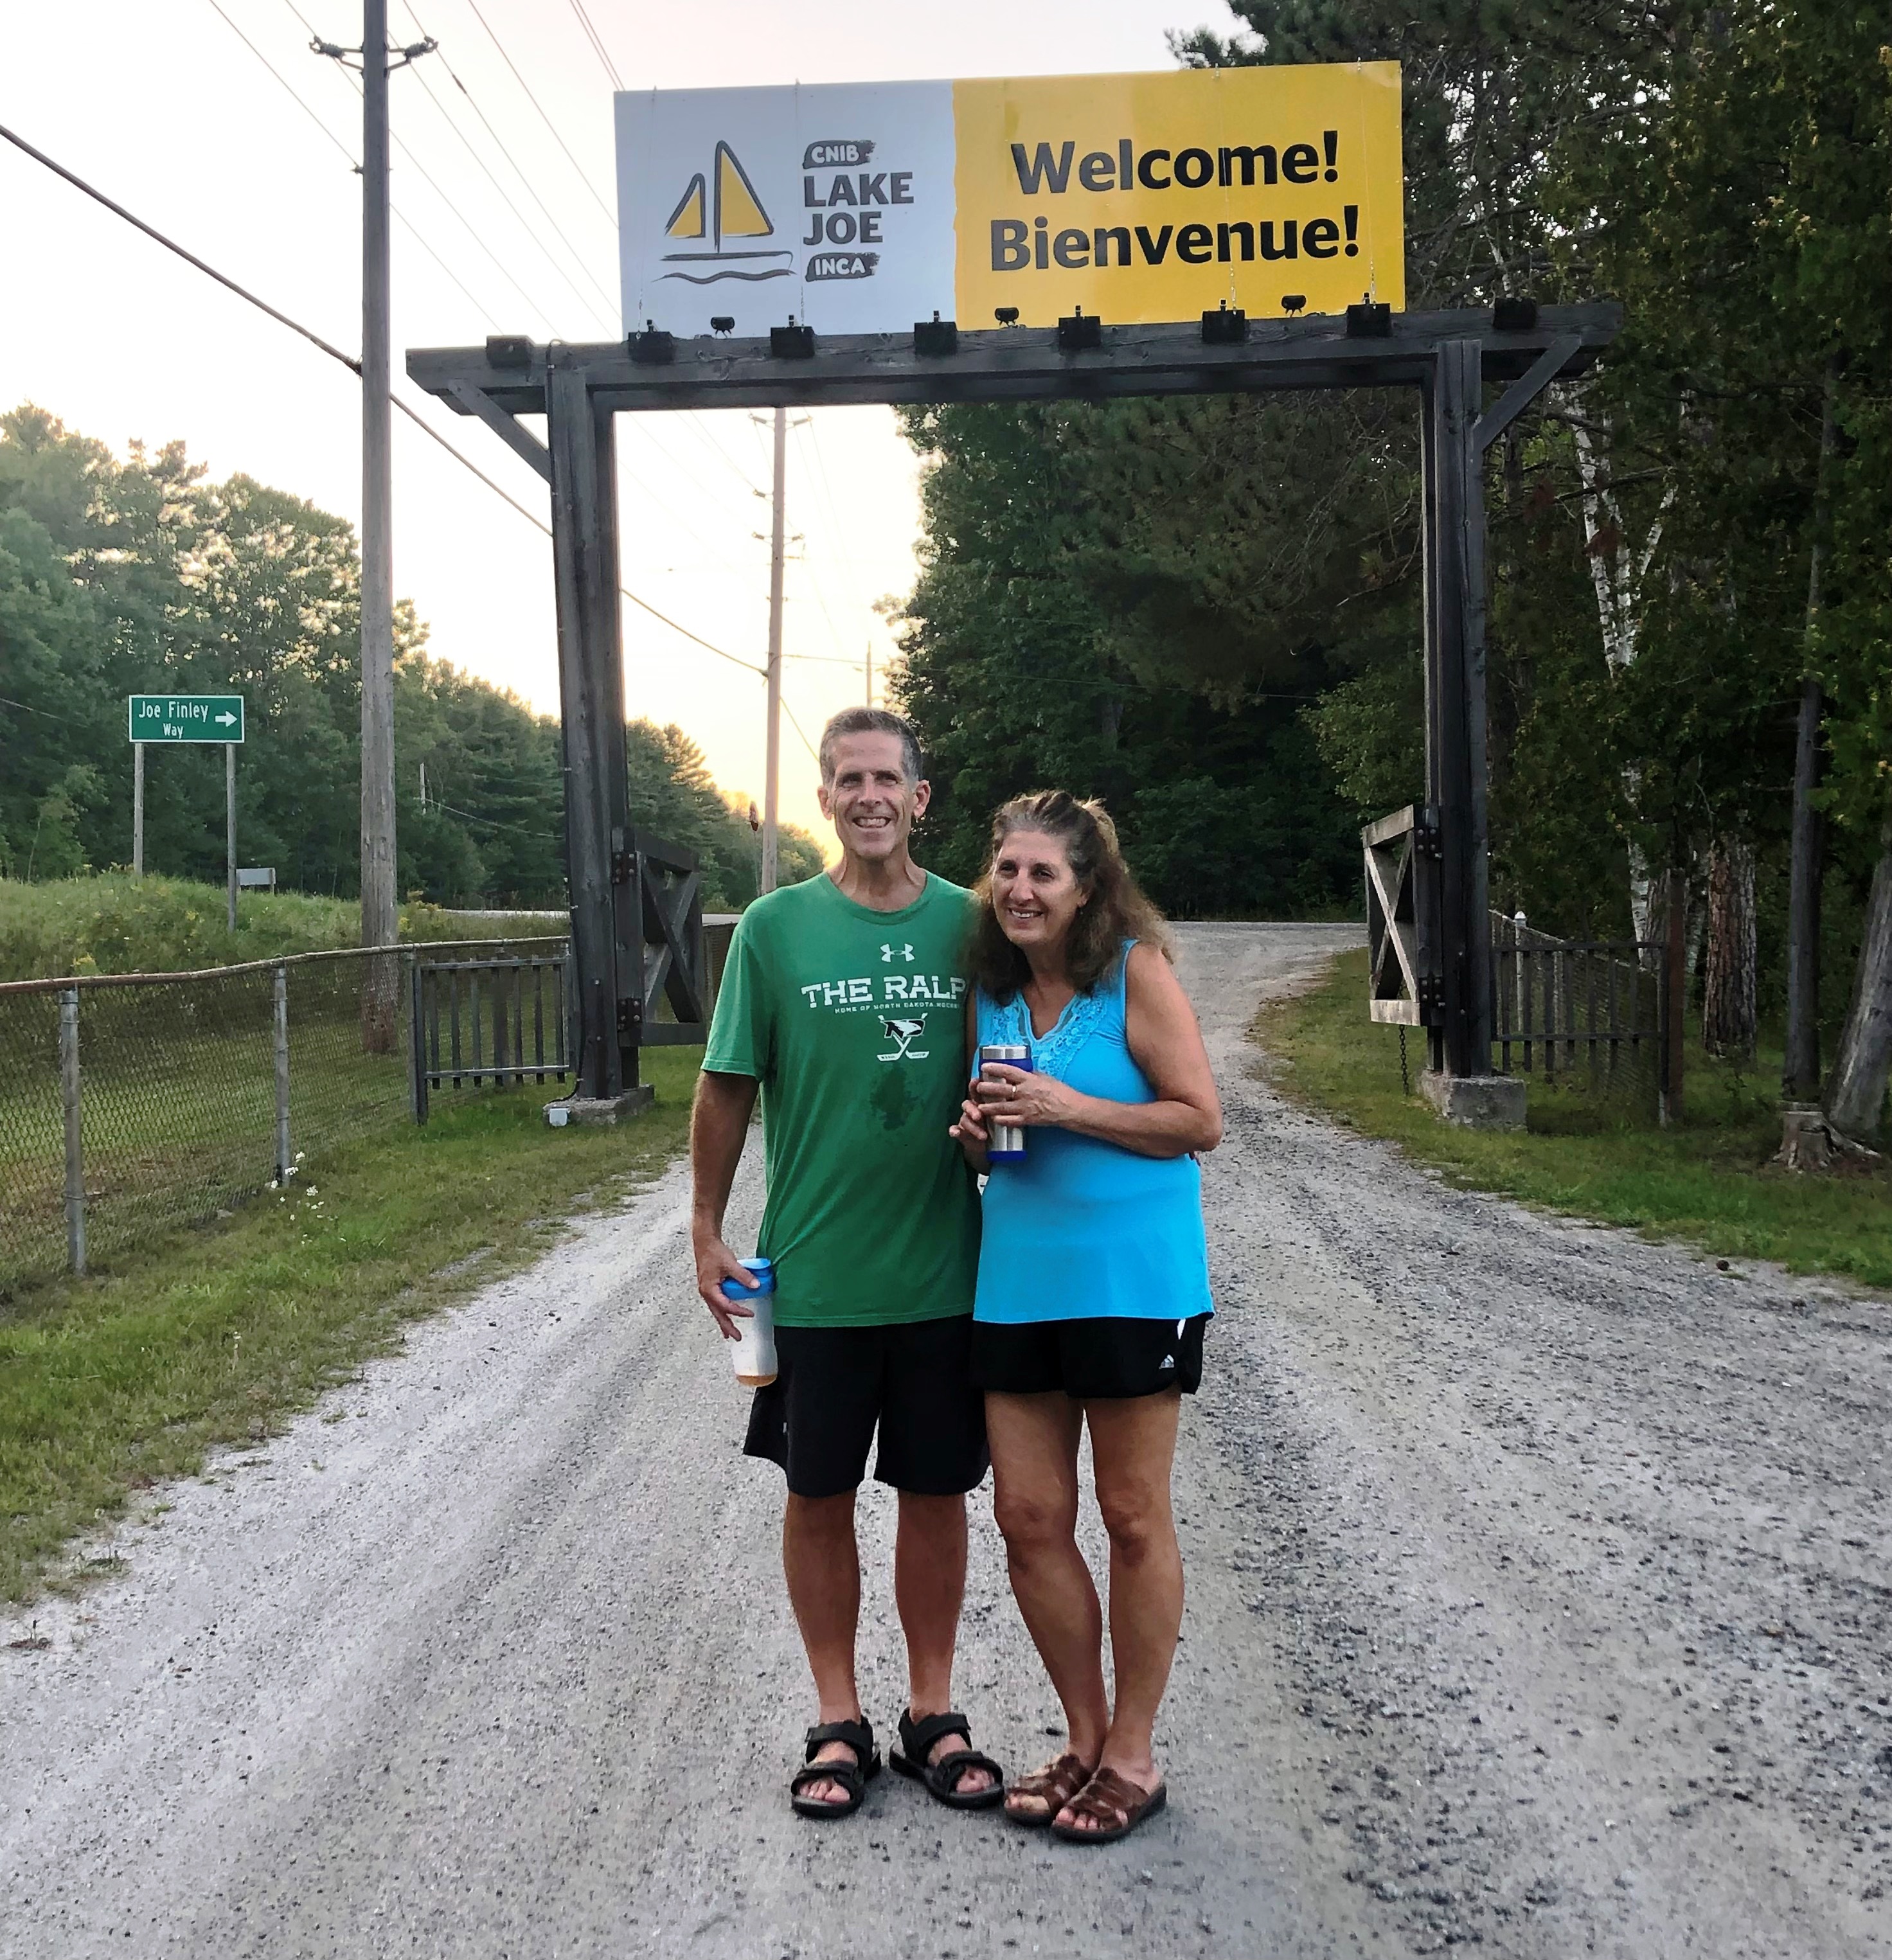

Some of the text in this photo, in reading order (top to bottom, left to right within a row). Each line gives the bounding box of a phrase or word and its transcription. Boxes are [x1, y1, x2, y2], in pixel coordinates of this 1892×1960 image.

[811, 145, 860, 164] CNIB
[1010, 130, 1339, 195] Welcome!
[803, 172, 915, 208] LAKE
[803, 211, 884, 246] JOE
[990, 204, 1360, 272] Bienvenue!
[815, 258, 866, 276] INCA
[138, 700, 209, 723] Joe Finley
[163, 723, 184, 740] Way
[801, 977, 873, 1008] THE
